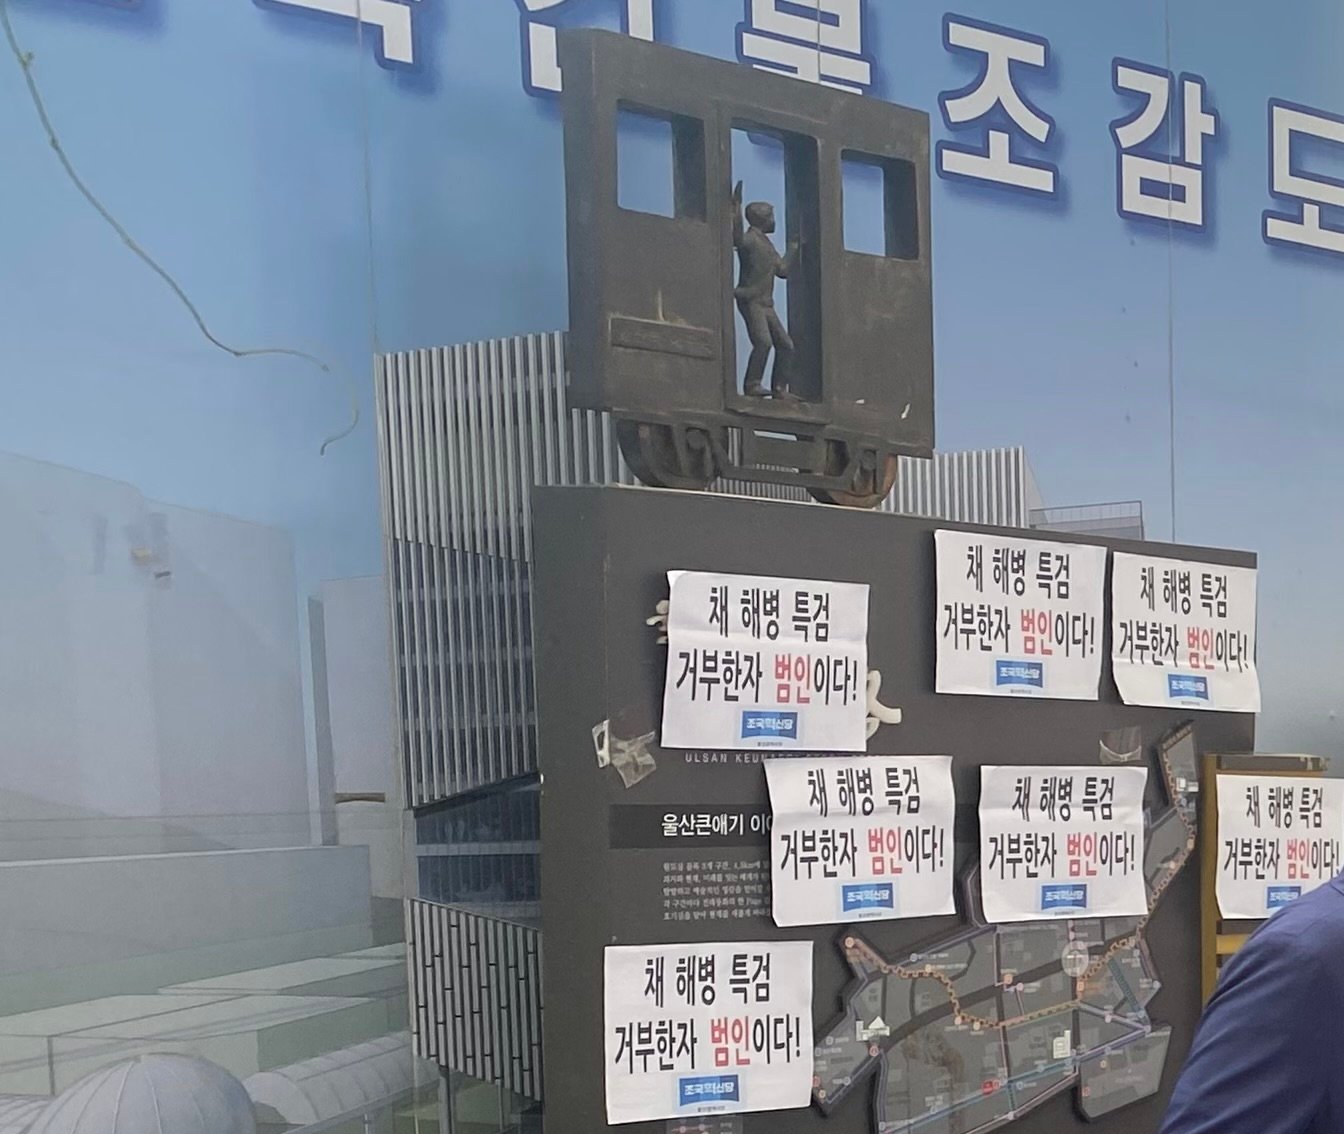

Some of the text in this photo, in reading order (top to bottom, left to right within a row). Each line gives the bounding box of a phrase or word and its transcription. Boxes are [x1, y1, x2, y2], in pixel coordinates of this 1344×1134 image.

[967, 544, 1069, 599] 채 해병 특검
[1140, 567, 1227, 618] 채 해병 특검
[709, 586, 829, 642] 채 해병 특검
[944, 602, 1094, 658] 거부한자 범인이다!
[1119, 620, 1248, 673] 거부한자 범인이다!
[676, 649, 858, 706] 거부한자 범인이다!
[685, 753, 728, 763] ULSAN
[808, 767, 920, 817] 채 해병 특검
[1012, 776, 1114, 822] 채 해병 특검
[1246, 785, 1323, 829] 채 해병 특검
[661, 814, 743, 836] 울산큰애기
[781, 825, 944, 880] 거부한자 범인이다!
[989, 831, 1135, 879] 거부한자 범인이다!
[1224, 838, 1340, 880] 거부한자 범인이다!
[644, 952, 770, 1008] 채 해병 특검
[615, 1013, 800, 1074] 거부한자 범인이다!
